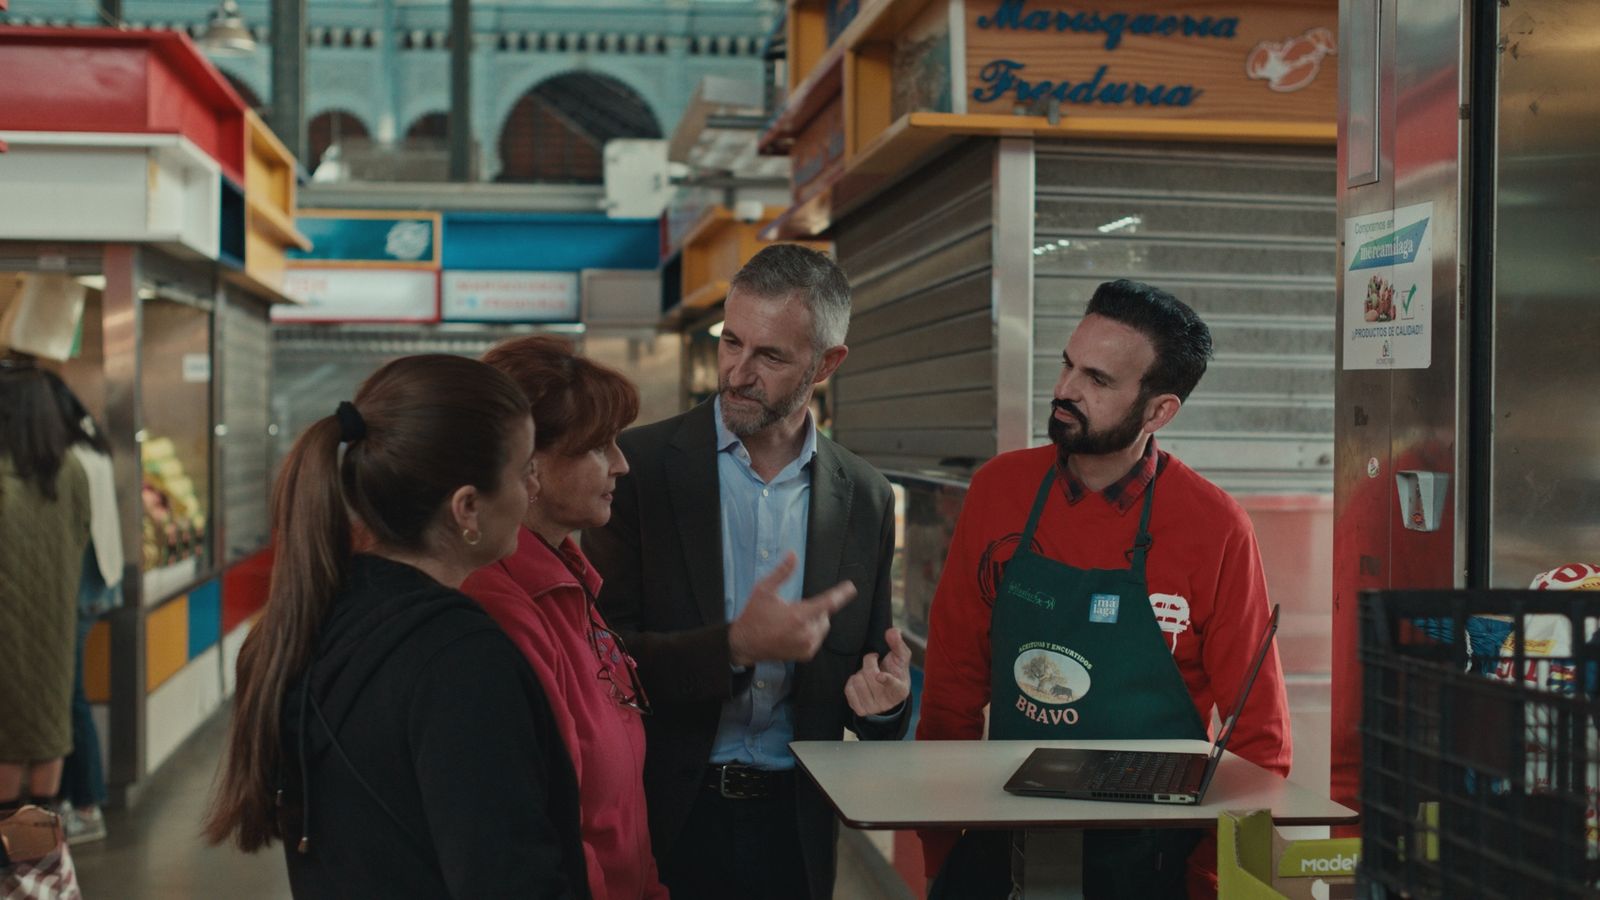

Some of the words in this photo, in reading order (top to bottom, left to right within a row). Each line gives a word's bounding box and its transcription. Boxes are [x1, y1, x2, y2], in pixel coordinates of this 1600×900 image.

[1389, 326, 1395, 337] DE
[1093, 604, 1115, 617] laga
[1051, 643, 1093, 670] ENCURTIDOS
[1015, 694, 1079, 725] BRAVO
